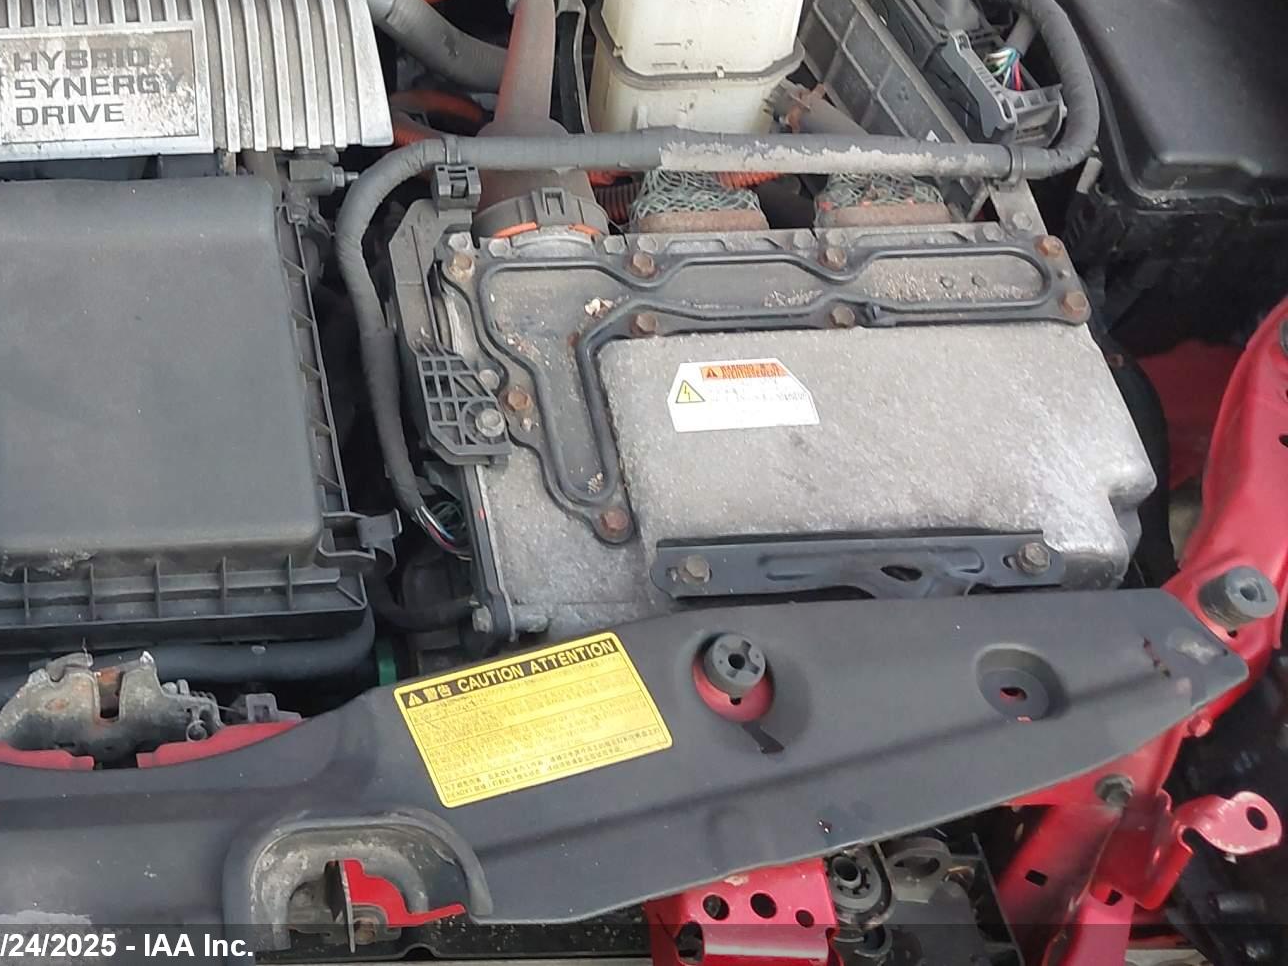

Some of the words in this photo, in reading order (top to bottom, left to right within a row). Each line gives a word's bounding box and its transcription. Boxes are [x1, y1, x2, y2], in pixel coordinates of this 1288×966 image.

[13, 47, 151, 72] HYBRID
[14, 73, 185, 99] SYNERGY
[15, 102, 125, 127] DRIVE
[457, 665, 525, 693] CAUTION
[529, 639, 616, 675] ATTENTION
